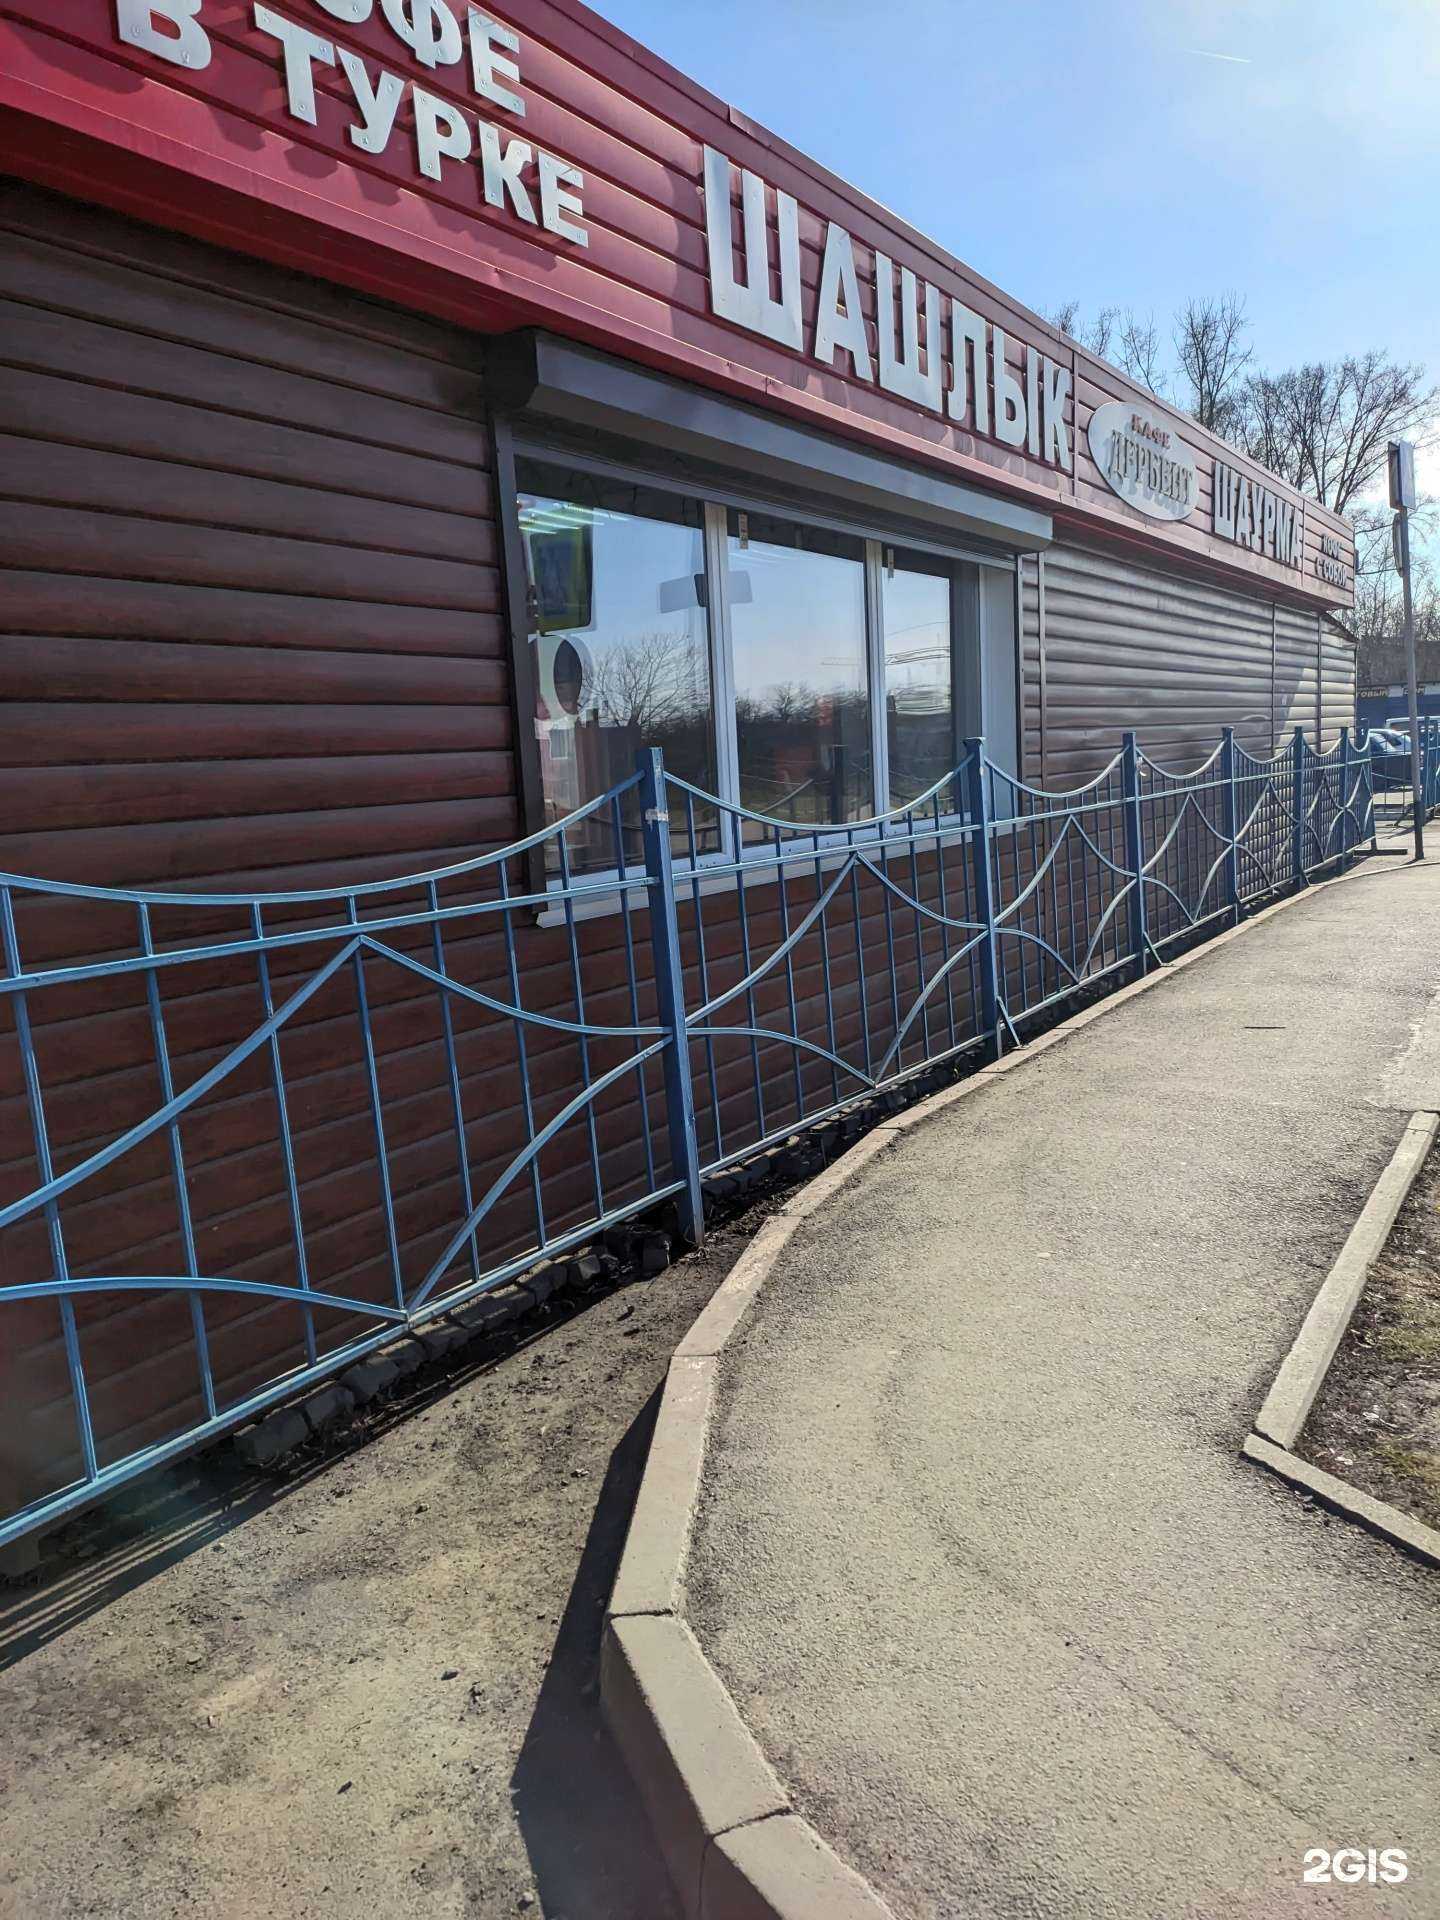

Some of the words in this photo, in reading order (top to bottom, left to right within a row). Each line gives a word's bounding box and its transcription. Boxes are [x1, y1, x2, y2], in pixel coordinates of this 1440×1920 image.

[314, 0, 526, 118] ФЕ
[118, 0, 212, 70] В
[254, 2, 589, 248] ТУРКЕ
[703, 143, 1073, 473] ШАШЛЫК
[1107, 429, 1193, 504] ДЕРБЕНТ
[1130, 414, 1170, 449] КАФЕ
[1214, 460, 1303, 569] ШАУРМА
